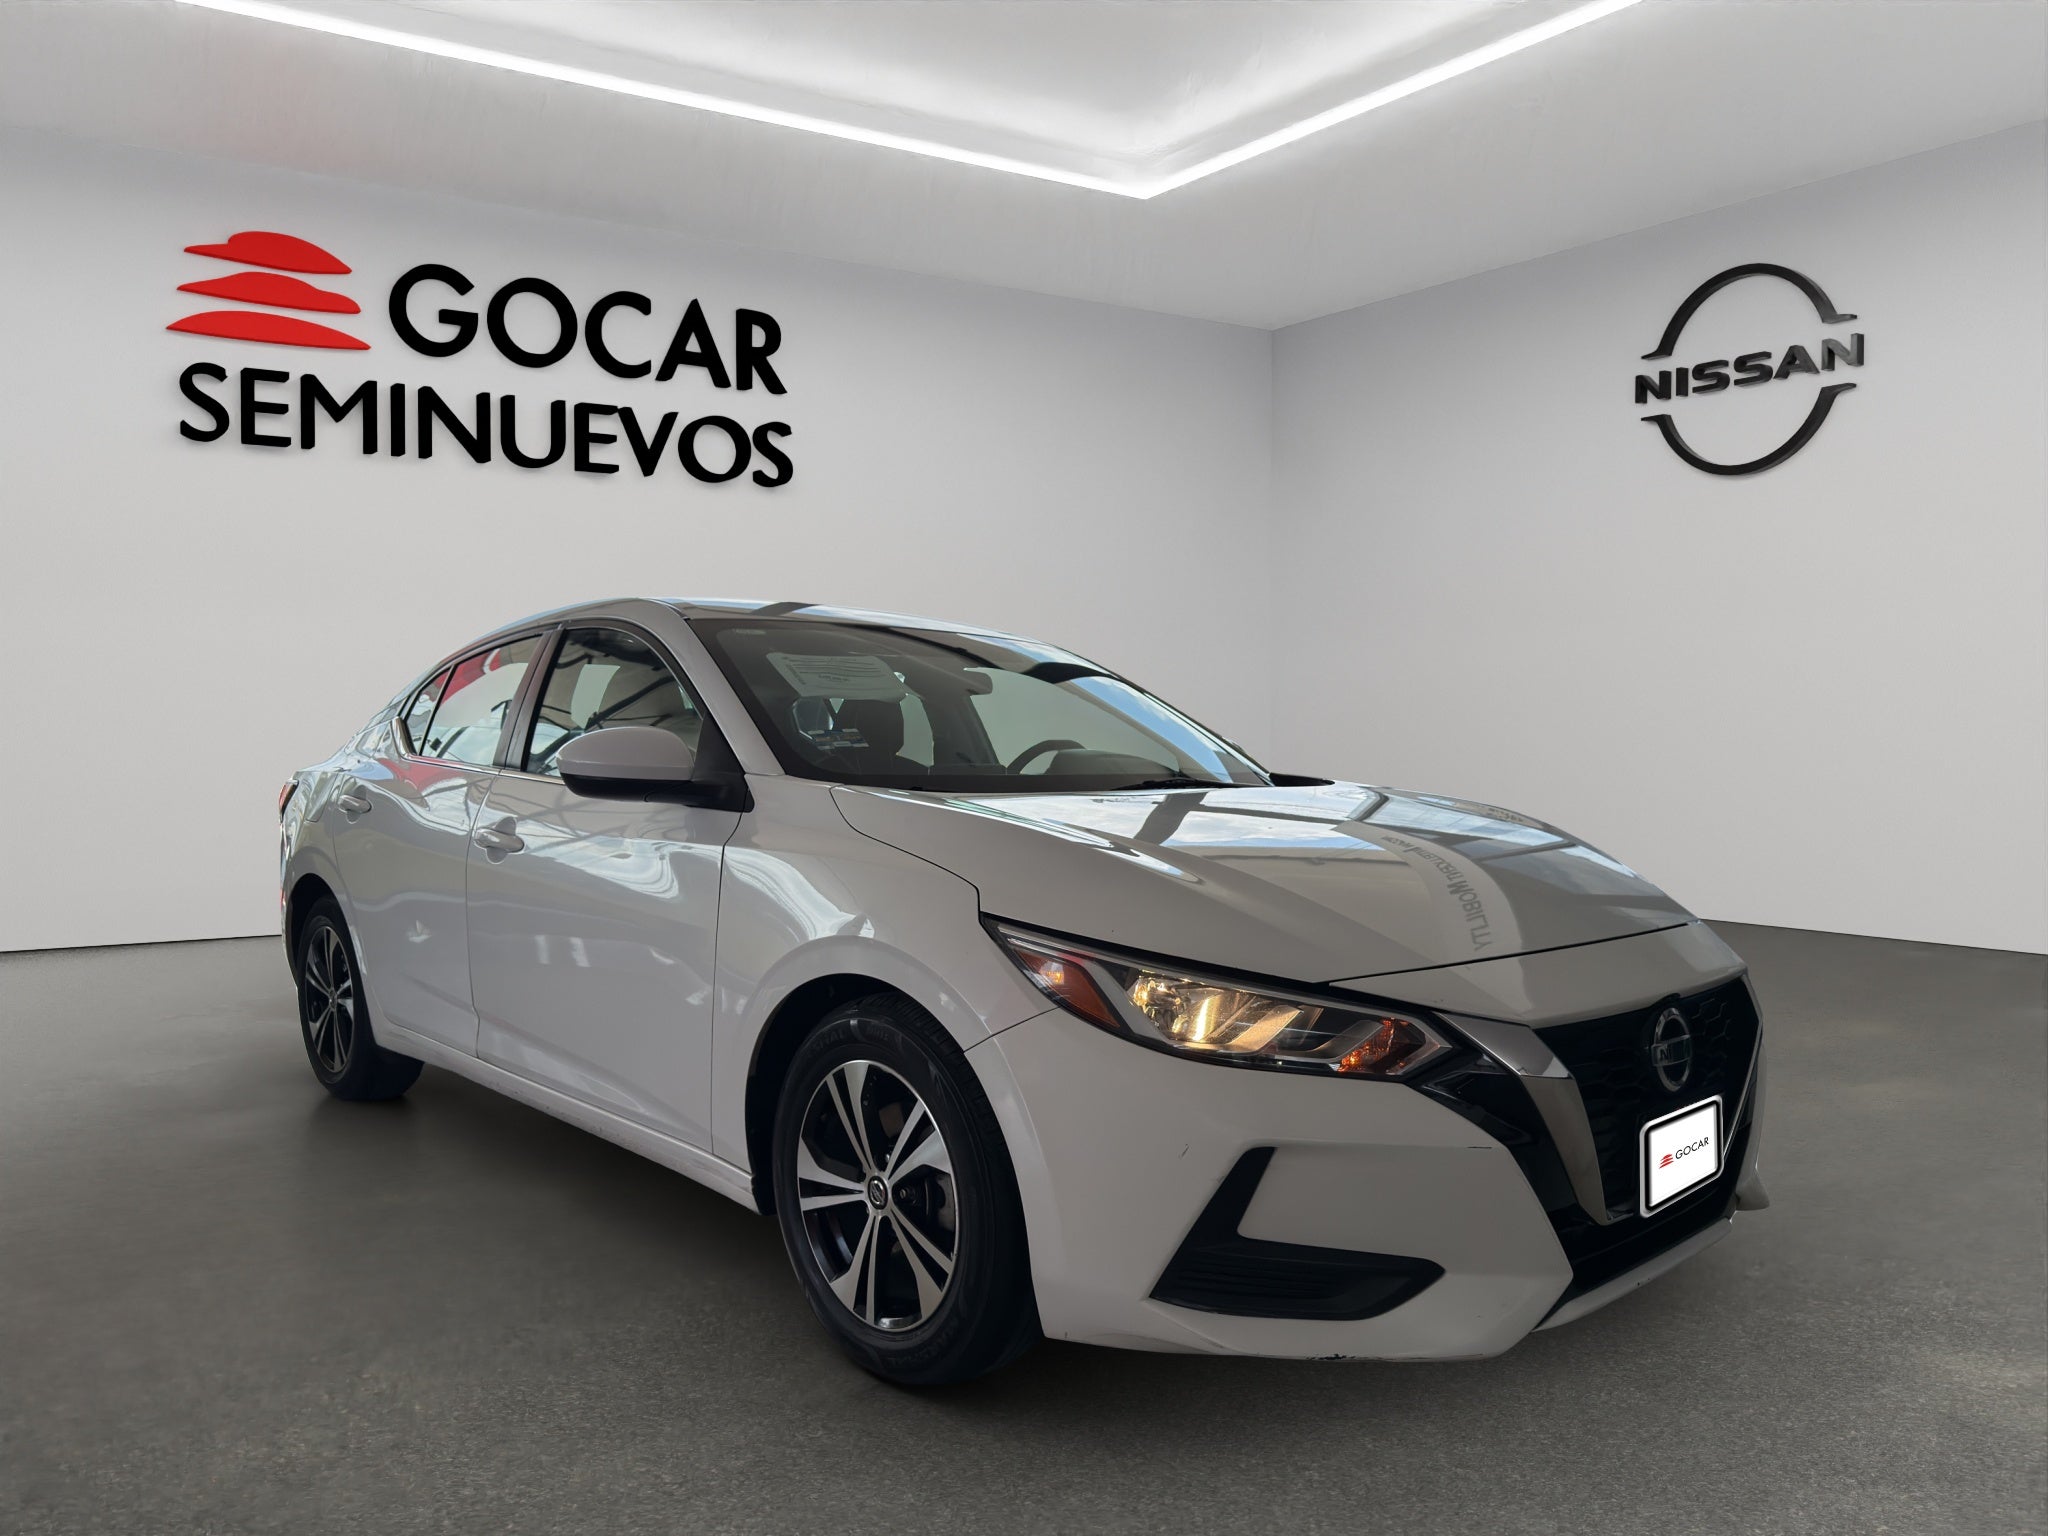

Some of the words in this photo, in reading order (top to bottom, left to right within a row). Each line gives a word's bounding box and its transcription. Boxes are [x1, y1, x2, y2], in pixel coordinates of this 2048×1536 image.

[388, 263, 788, 395] GOCAR
[1634, 332, 1865, 404] NISSAN
[178, 361, 794, 488] SEMINUEVOS
[1675, 1136, 1709, 1160] GOCAR
